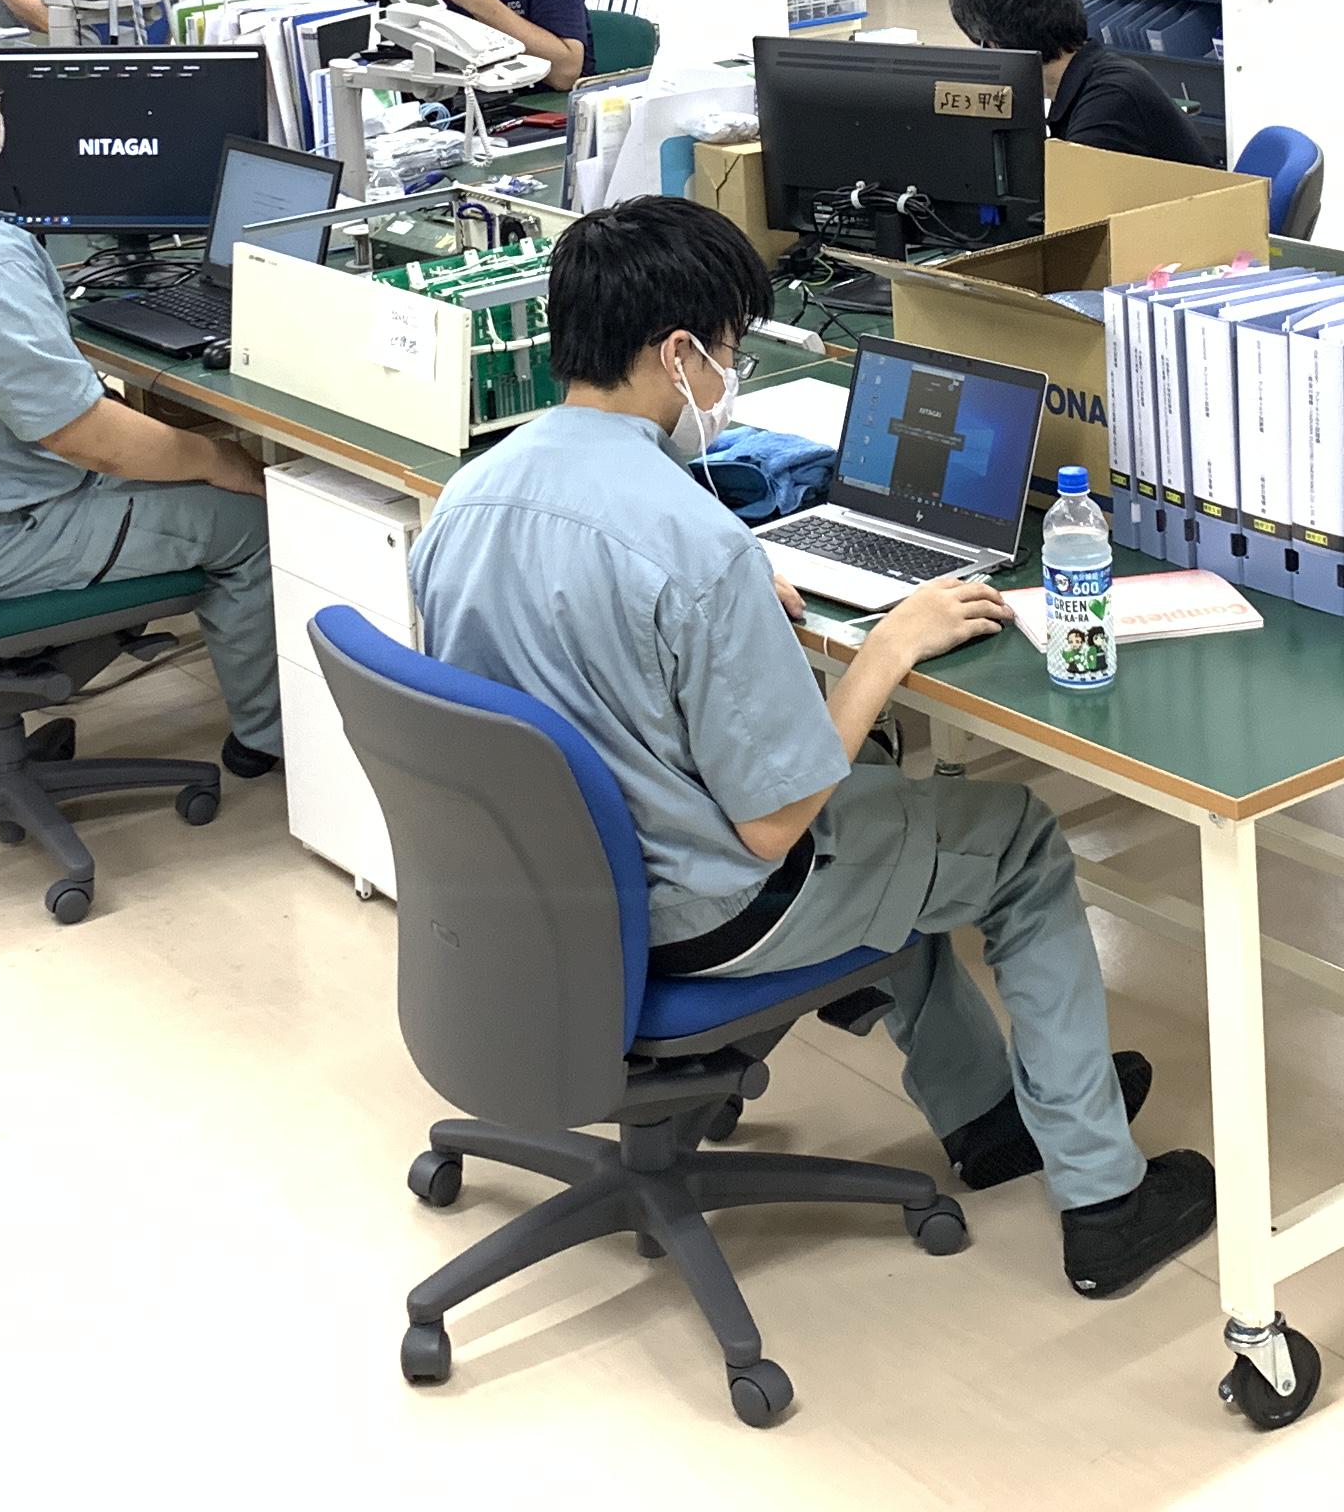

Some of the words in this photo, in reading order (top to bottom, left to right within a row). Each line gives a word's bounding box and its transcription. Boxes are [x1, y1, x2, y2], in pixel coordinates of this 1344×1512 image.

[79, 138, 159, 156] NITAGAI
[1072, 582, 1100, 596] 600
[1054, 596, 1087, 612] GREEN
